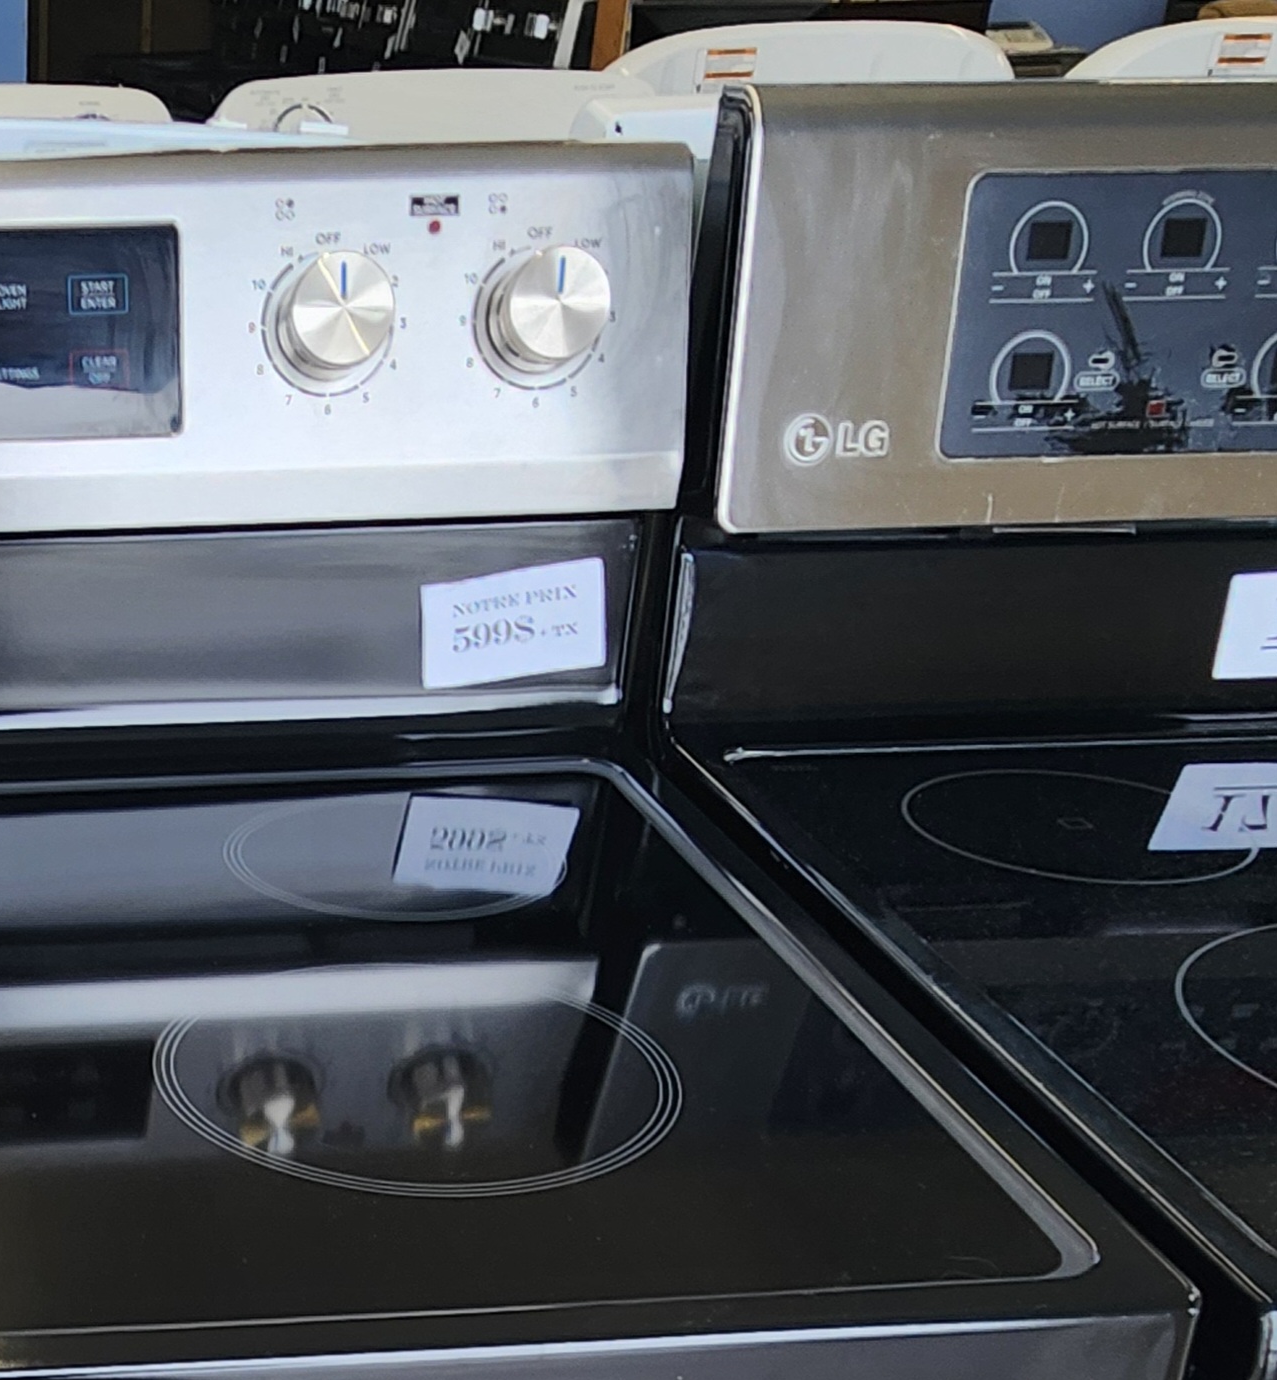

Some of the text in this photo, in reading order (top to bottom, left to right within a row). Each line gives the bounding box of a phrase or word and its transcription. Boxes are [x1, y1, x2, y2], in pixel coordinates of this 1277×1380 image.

[315, 232, 341, 245] OFF
[527, 226, 553, 239] OFF
[363, 244, 391, 255] LOW
[81, 281, 115, 293] START
[1032, 289, 1052, 299] OFF
[80, 298, 116, 310] ENTER
[82, 356, 117, 369] CLEAR
[1079, 376, 1115, 387] SELECT
[1205, 373, 1240, 383] SELECT
[835, 420, 890, 458] LG
[453, 584, 577, 618] NOTRE PRIX
[551, 621, 578, 637] TX
